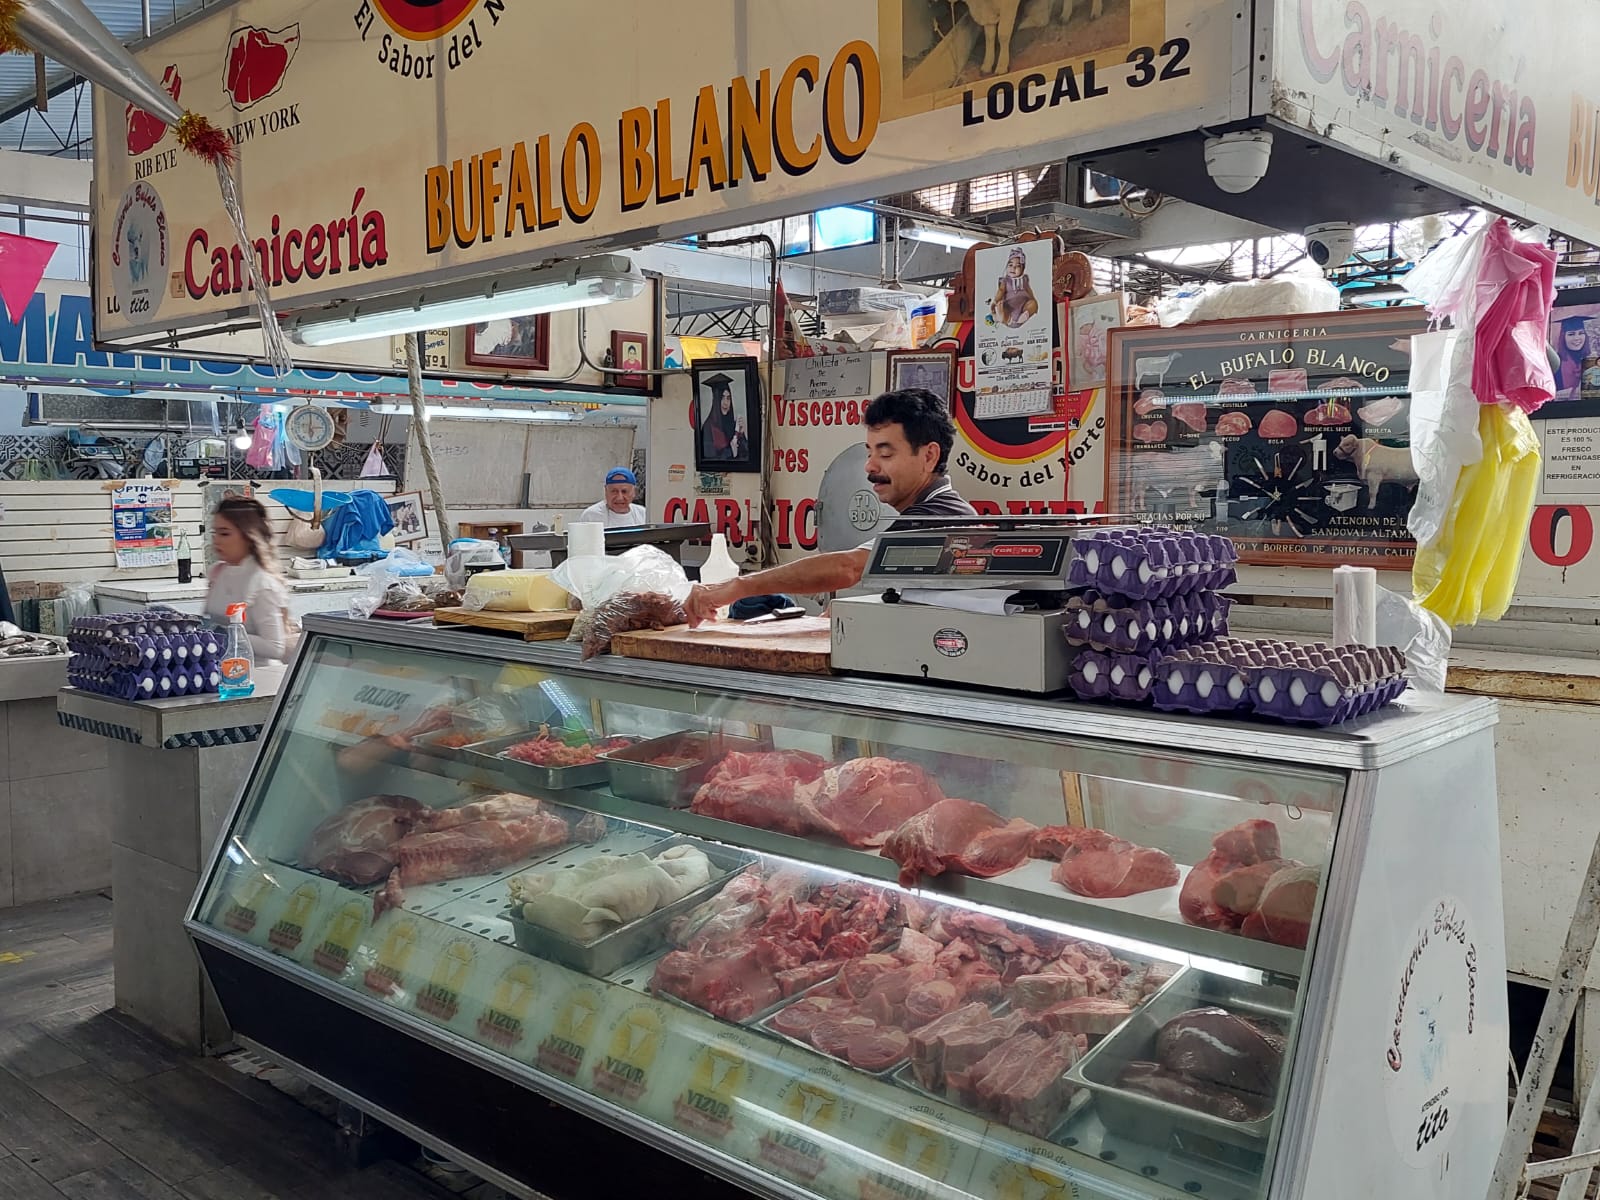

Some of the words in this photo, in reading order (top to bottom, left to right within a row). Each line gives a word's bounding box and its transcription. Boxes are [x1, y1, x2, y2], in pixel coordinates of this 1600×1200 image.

[354, 1, 375, 41] El
[378, 34, 435, 80] Sabor
[447, 20, 483, 71] del
[961, 59, 1108, 126] LOCAL
[1125, 37, 1191, 88] 32
[227, 120, 255, 146] NEW
[258, 103, 300, 138] YORK
[425, 121, 602, 254] BUFALO
[619, 40, 881, 213] BLANCO
[135, 158, 154, 180] RIB
[155, 148, 178, 174] EYE
[184, 187, 388, 300] Carnicería
[130, 298, 150, 314] tito
[1239, 327, 1328, 341] CARNICERIA
[1188, 372, 1213, 391] EL
[1220, 348, 1295, 377] BUFALO
[1307, 348, 1391, 383] BLANCO
[774, 448, 809, 473] res
[956, 451, 1012, 488] Sabor
[1019, 464, 1054, 488] del
[1058, 415, 1106, 472] Norte
[851, 510, 877, 523] BON
[1175, 512, 1192, 520] POR
[1194, 512, 1206, 520] SU
[1328, 516, 1380, 526] ATENCION
[1383, 517, 1397, 526] DE
[1311, 528, 1367, 538] SANDOVAL
[1263, 544, 1307, 553] BORREGO
[1312, 545, 1325, 554] DE
[1332, 546, 1378, 556] PRIMERA
[1384, 548, 1417, 557] CALID
[1416, 1104, 1449, 1152] tito
